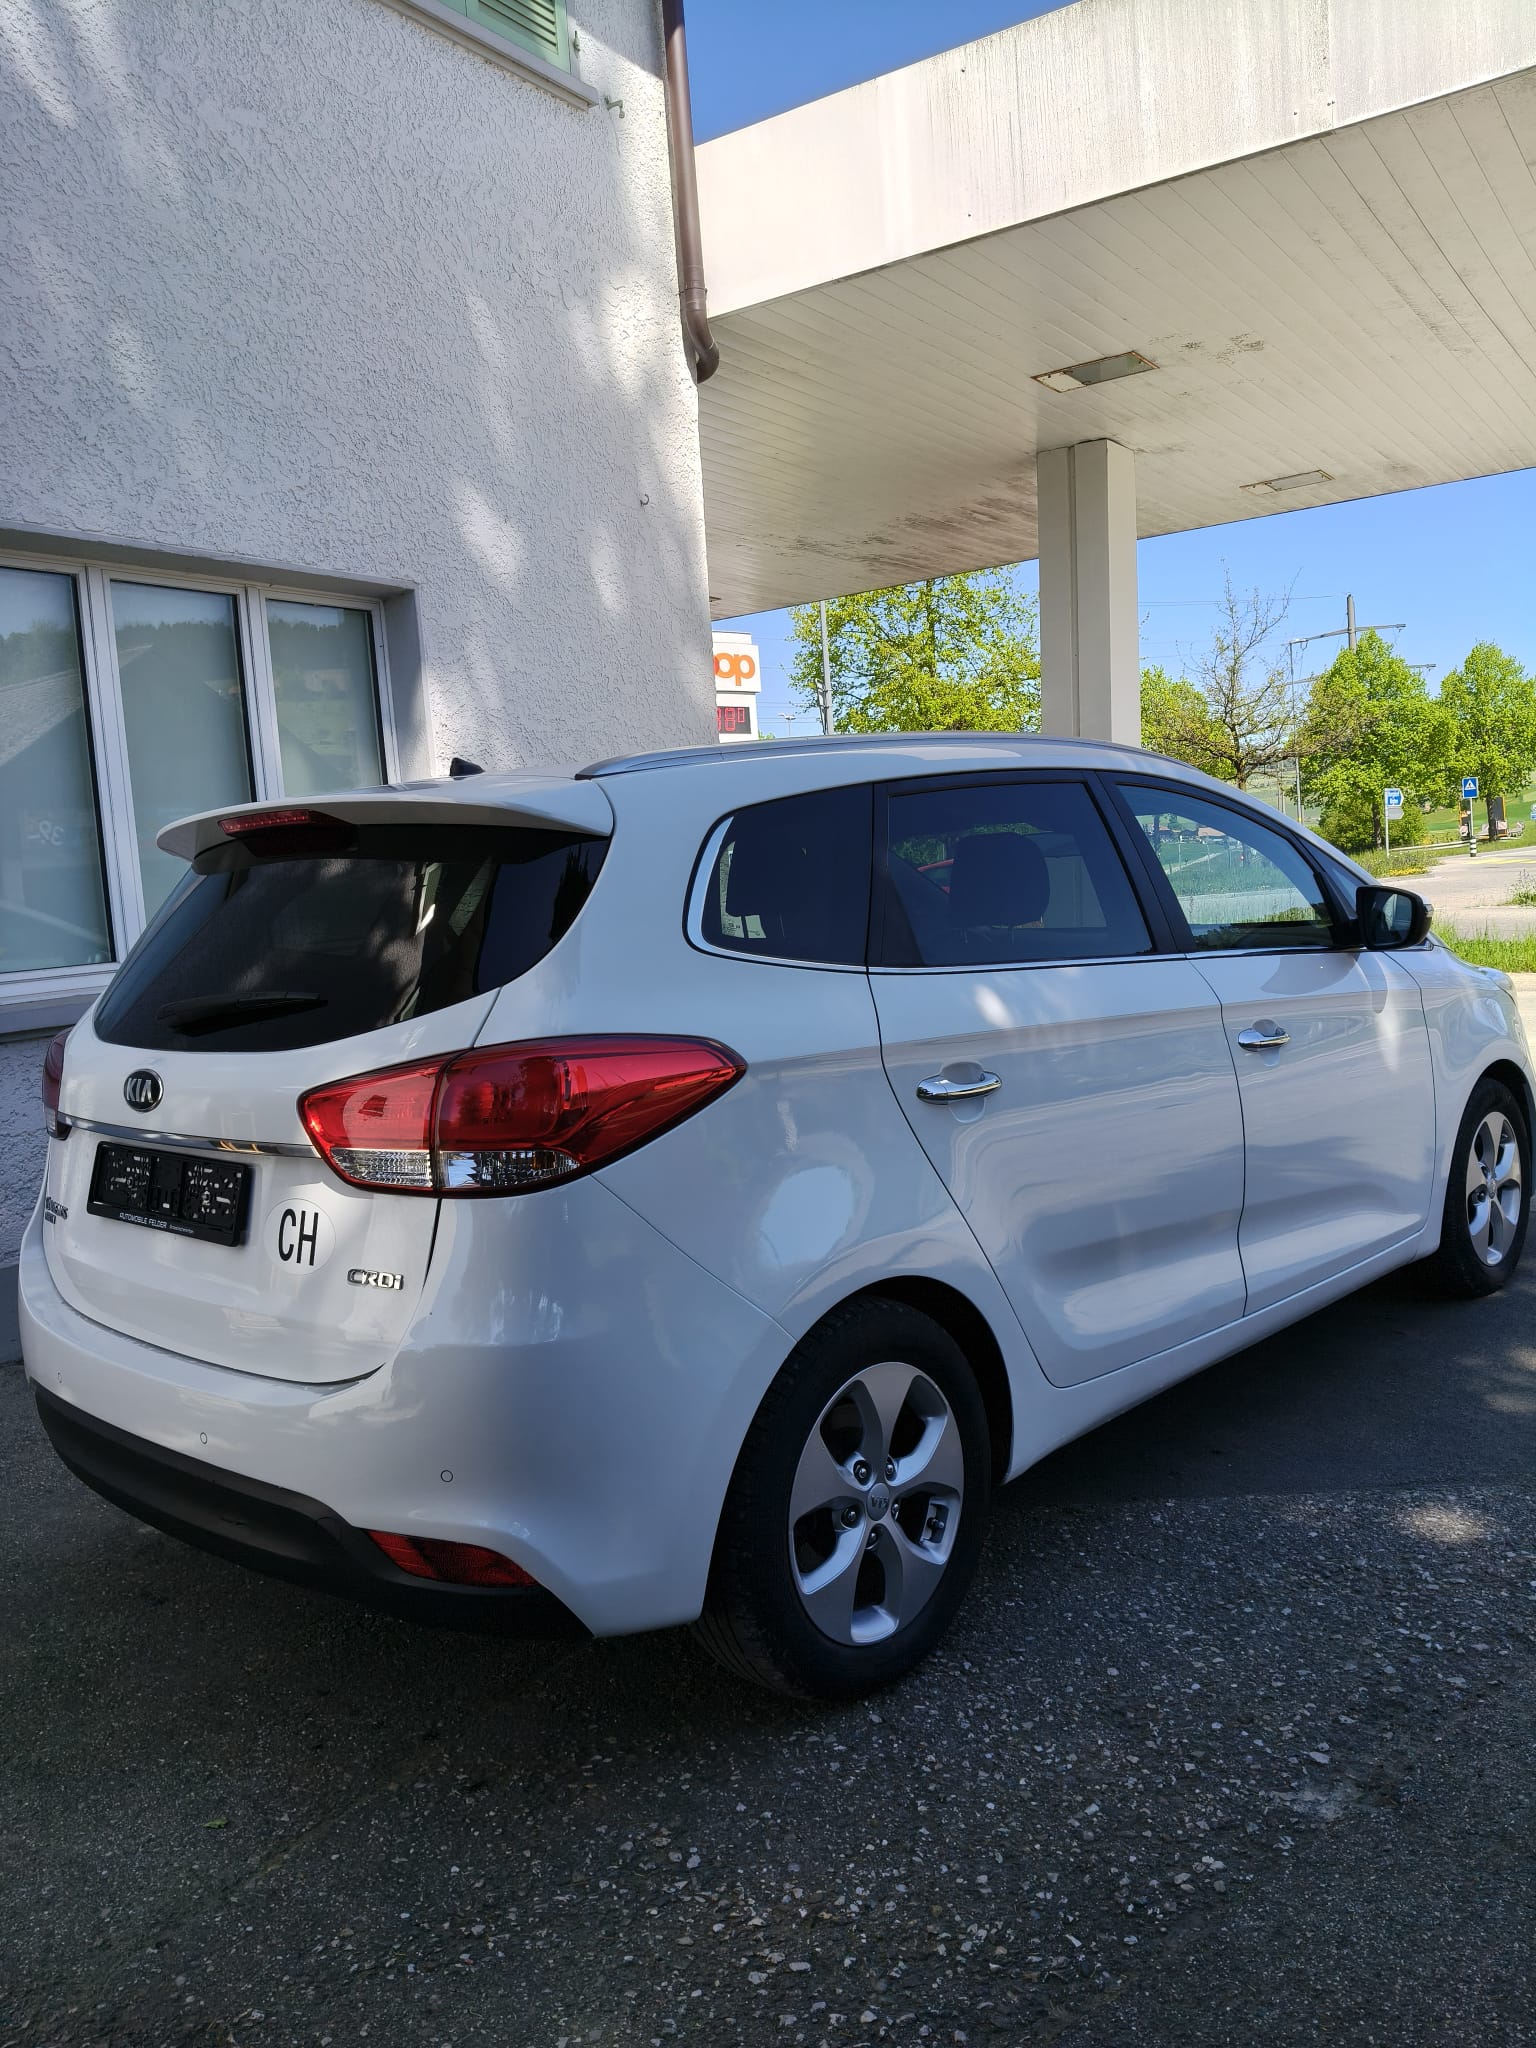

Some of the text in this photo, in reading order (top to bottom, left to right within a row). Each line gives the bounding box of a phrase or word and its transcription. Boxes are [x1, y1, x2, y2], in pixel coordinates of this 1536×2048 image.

[713, 652, 756, 686] op
[126, 1077, 154, 1103] KIA
[119, 1212, 148, 1225] AUTOMOBILE
[148, 1218, 168, 1229] FELDER
[278, 1208, 319, 1266] CH
[347, 1268, 404, 1290] CRDi
